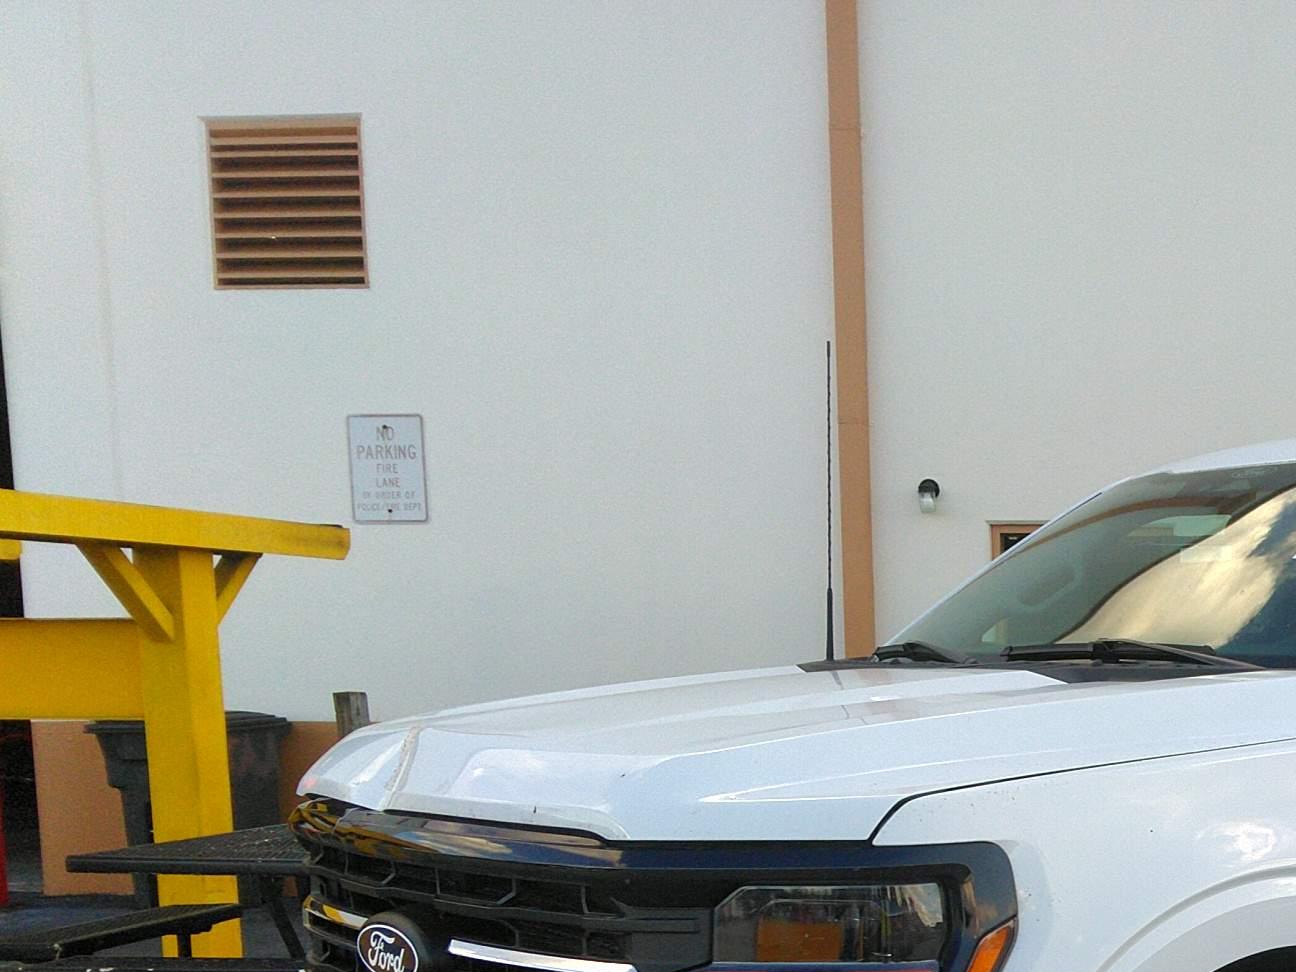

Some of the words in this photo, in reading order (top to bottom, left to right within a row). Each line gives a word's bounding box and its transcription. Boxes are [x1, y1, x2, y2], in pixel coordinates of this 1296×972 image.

[376, 425, 394, 441] NO
[357, 445, 416, 459] PARKING
[376, 463, 399, 474] FIRE
[376, 478, 400, 489] LANE
